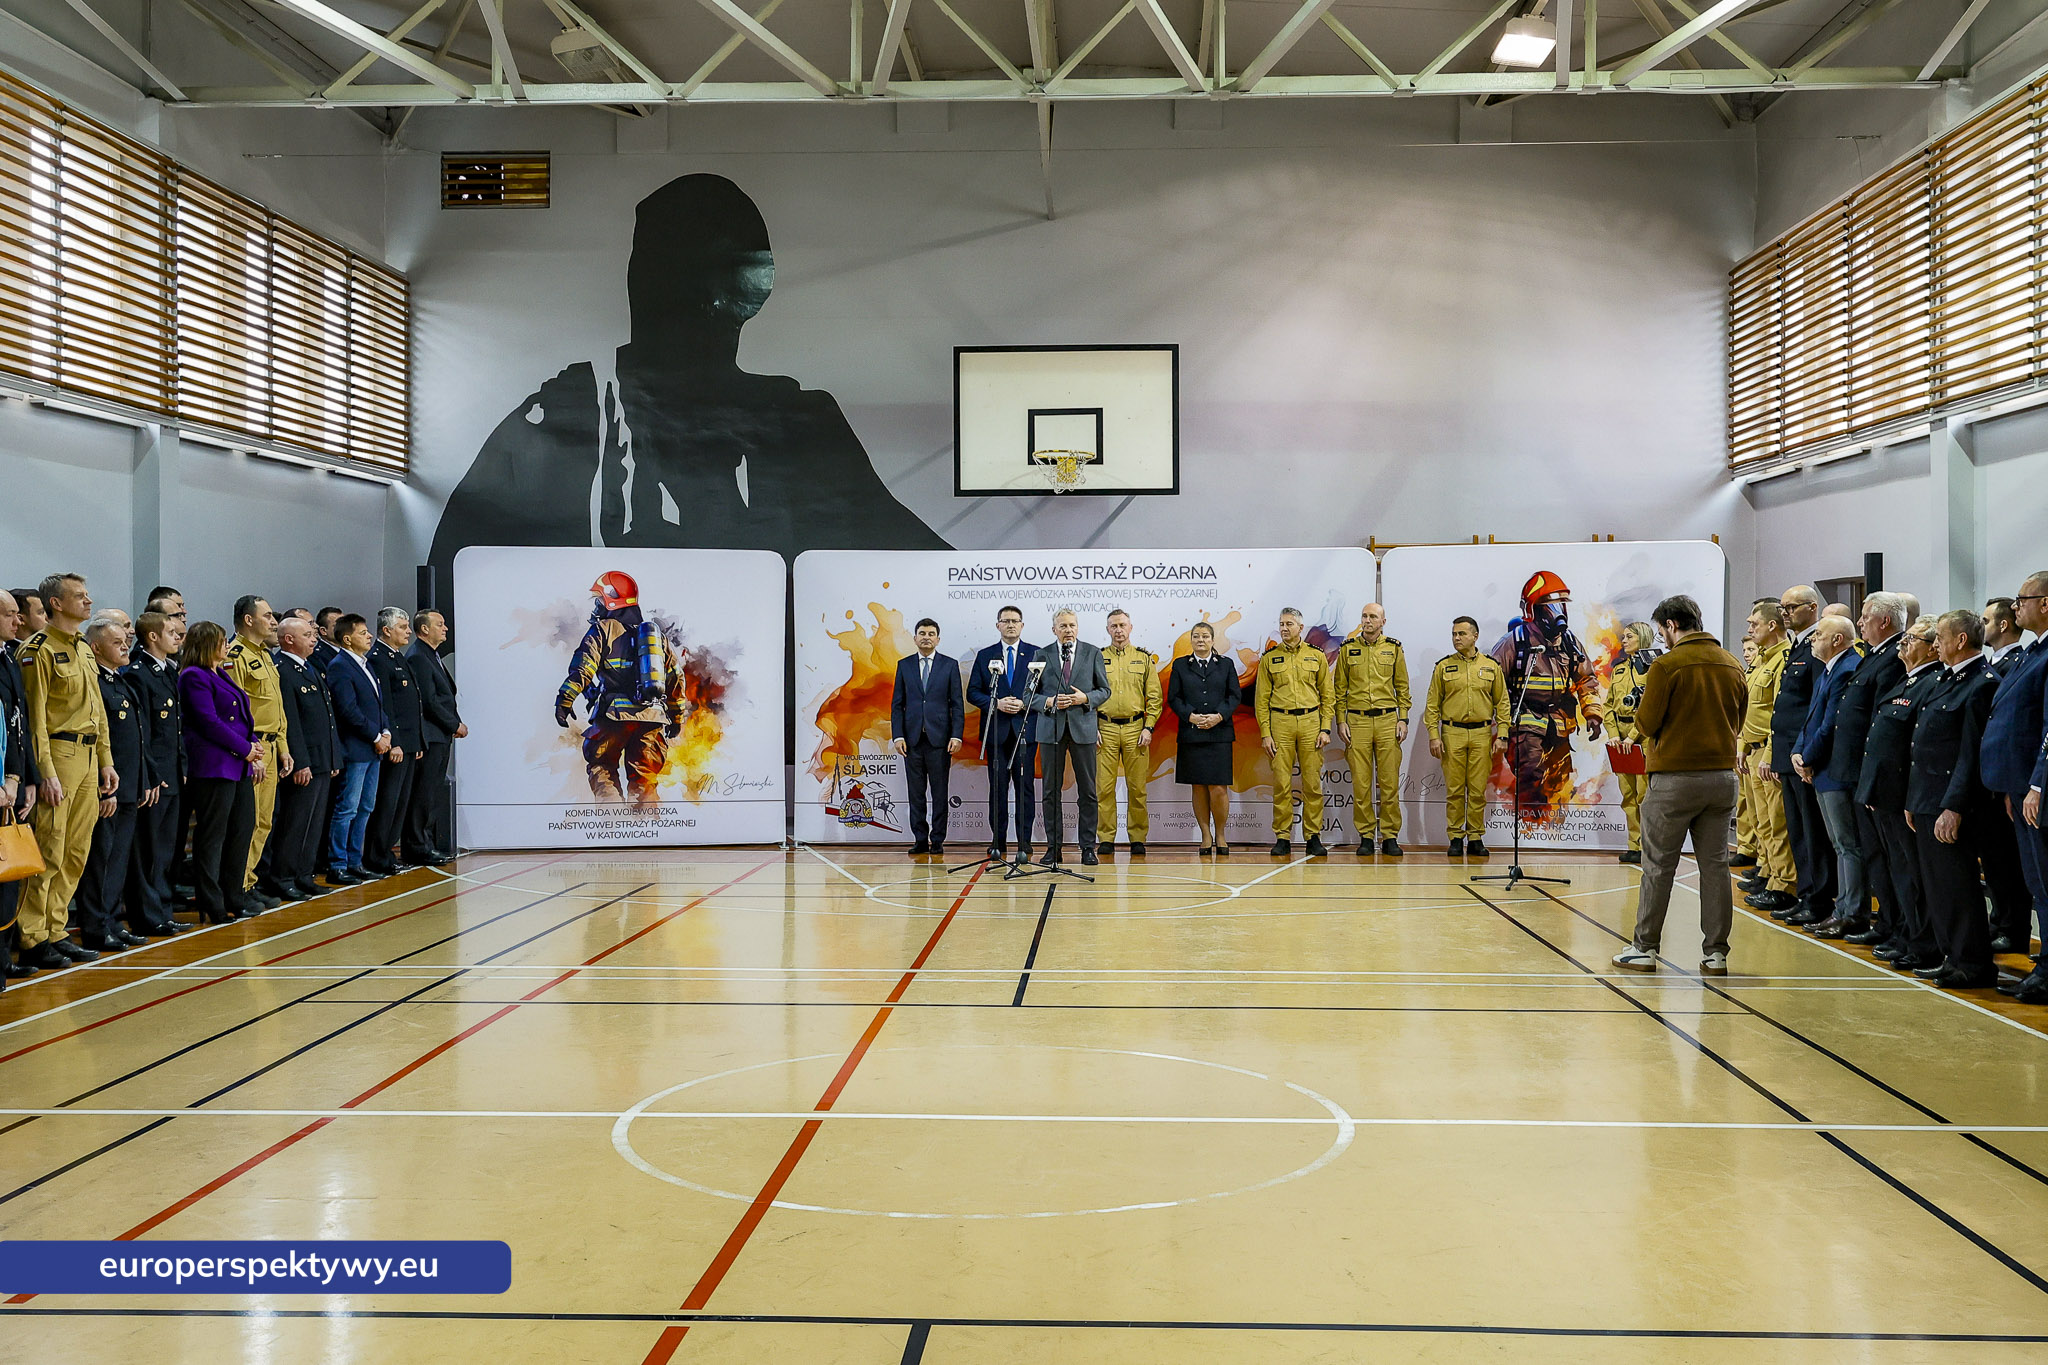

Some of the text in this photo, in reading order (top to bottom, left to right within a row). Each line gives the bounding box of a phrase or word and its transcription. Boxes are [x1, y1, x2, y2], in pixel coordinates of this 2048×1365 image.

[948, 563, 1217, 581] PAŃSTWOWA STRAŻ POŻARNA
[948, 587, 1218, 600] KOMENDA WOJEWÓDZKA PAŃSTWOWEJ STRAŻY POŻARNEJ
[1046, 603, 1056, 612] W
[843, 762, 896, 777] ŚLĄSKIE
[565, 807, 678, 817] KOMENDA WOJEWÓDZKA
[1538, 809, 1606, 818] WOJEWÓDZKA
[549, 818, 696, 830] PAŃSTWOWEJ STRAŻY POŻARNEJ
[1485, 820, 1625, 831] ŃSTWOWEJ STRAŻY POŻARNEJ
[598, 830, 658, 839] KATOWICACH
[1524, 832, 1586, 841] KATOWICACH
